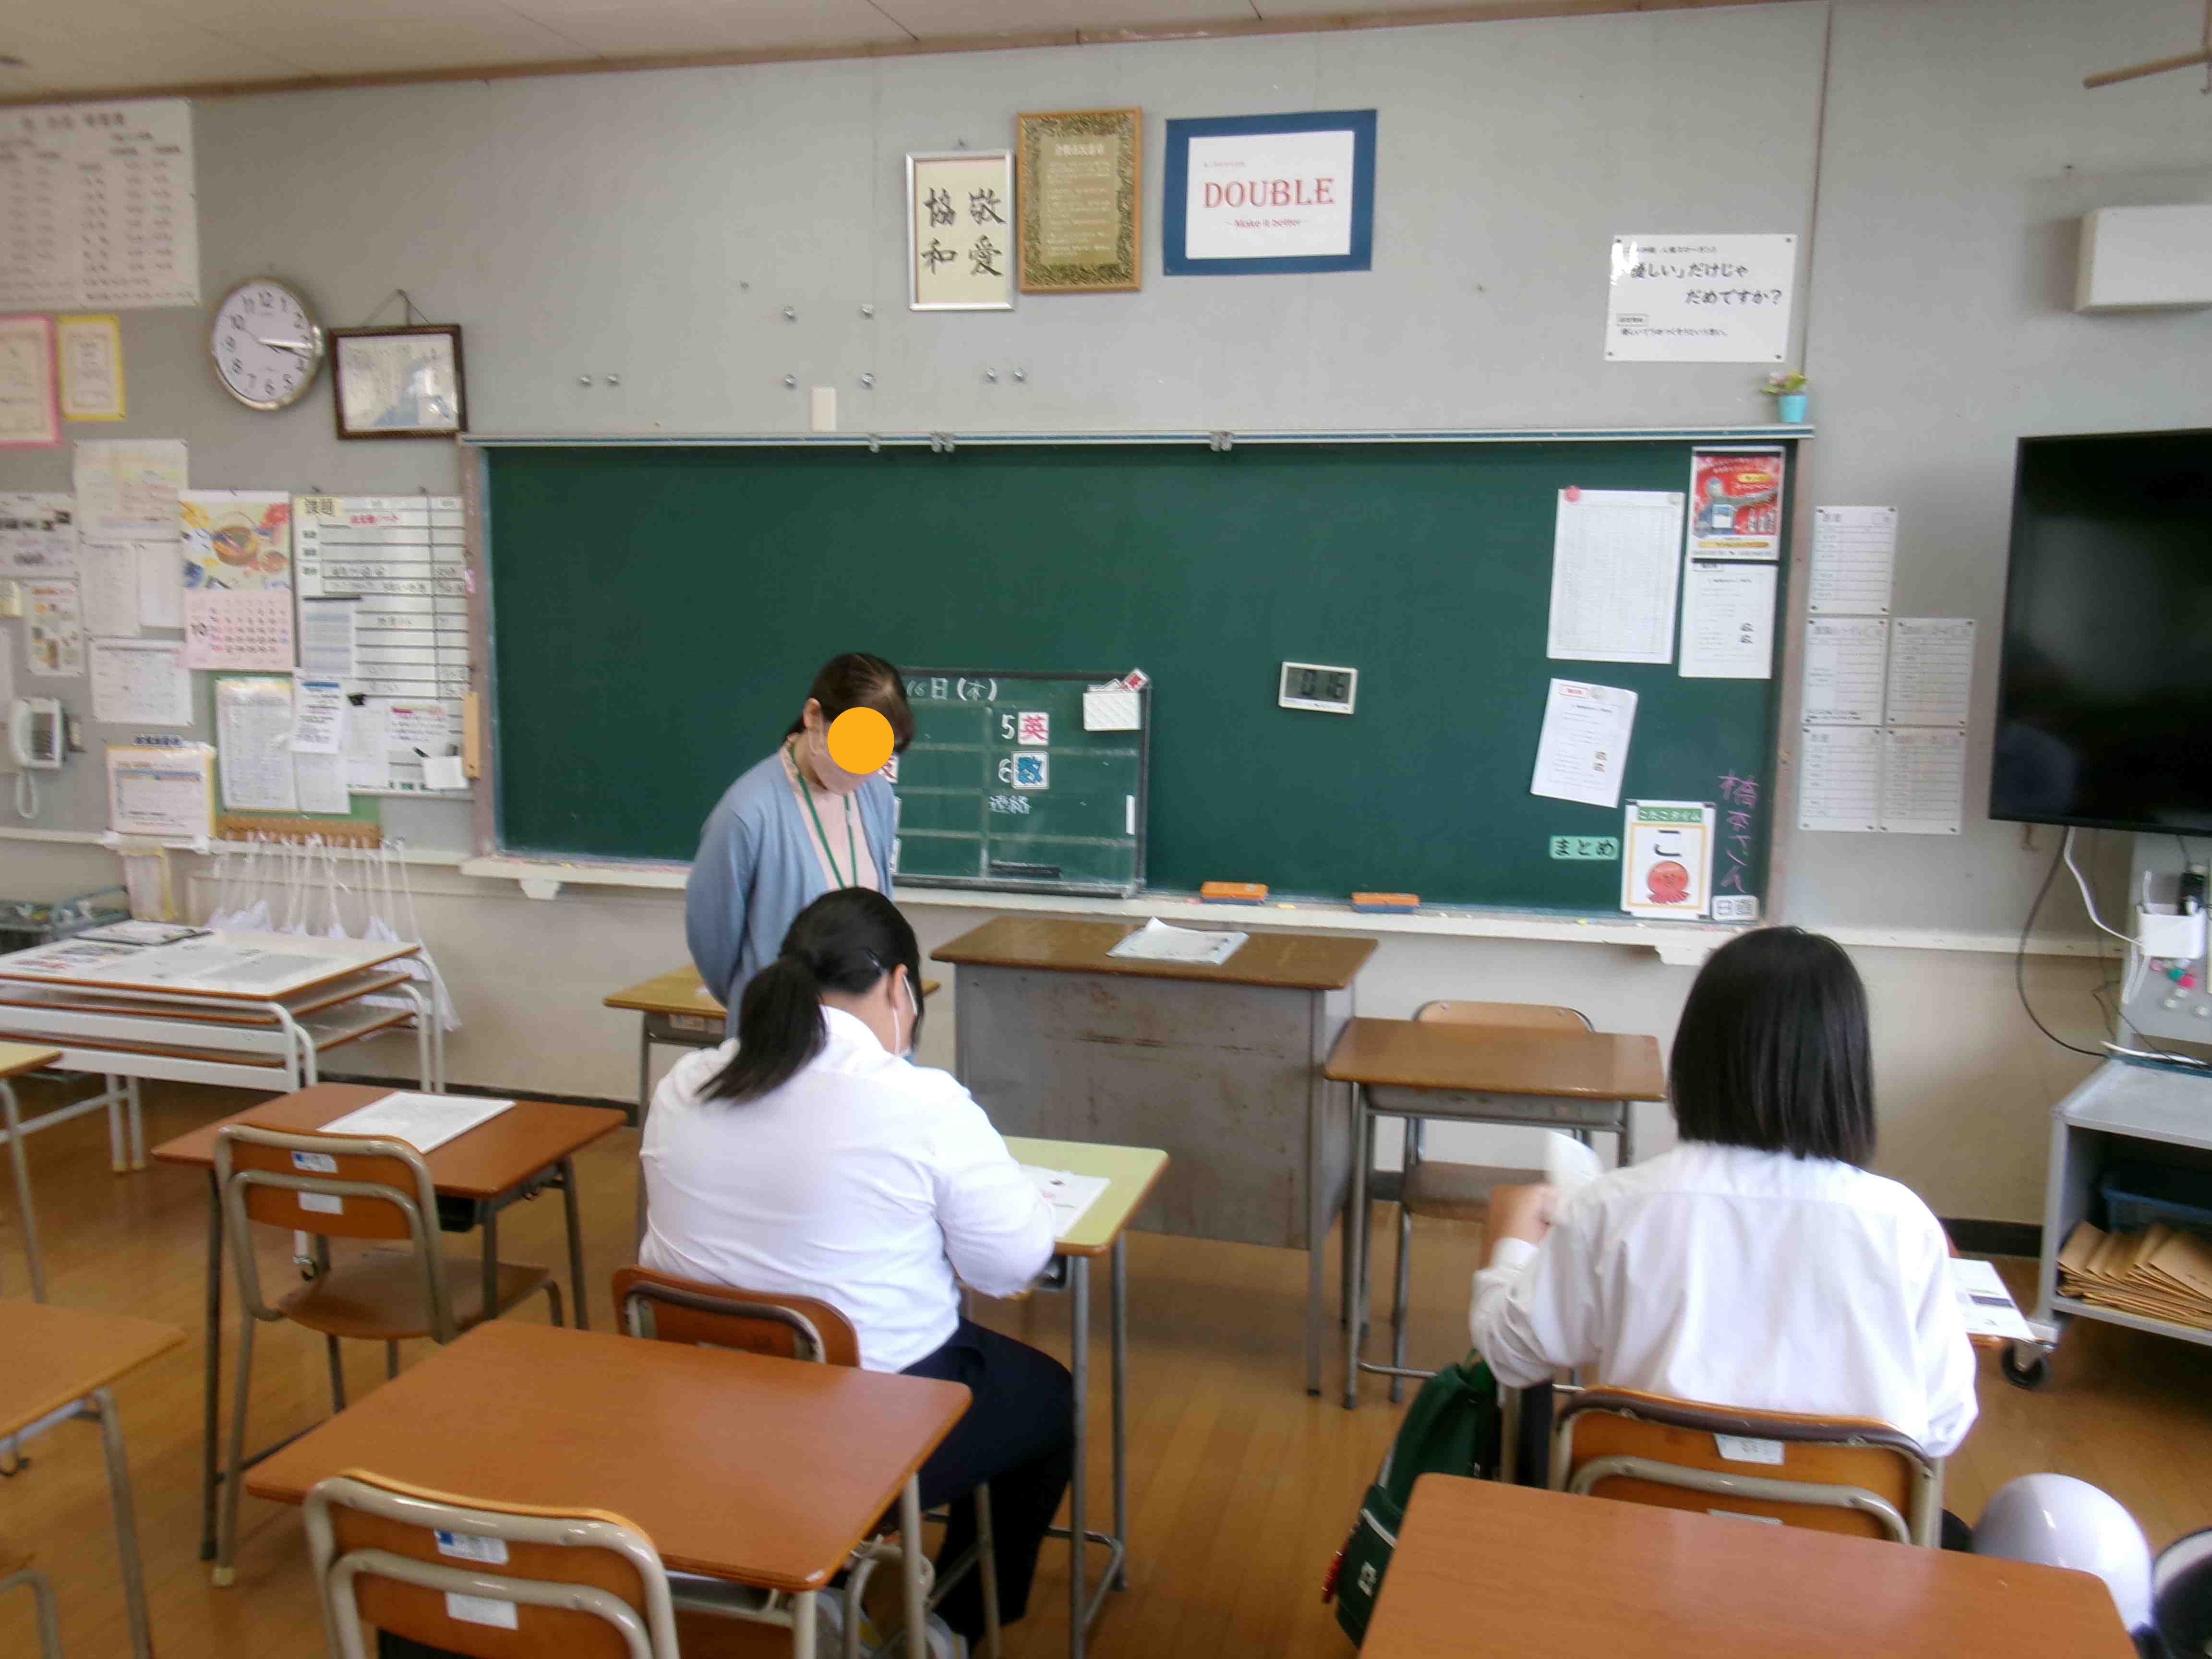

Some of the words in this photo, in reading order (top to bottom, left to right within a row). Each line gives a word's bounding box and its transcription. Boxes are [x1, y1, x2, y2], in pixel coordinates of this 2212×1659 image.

[1203, 178, 1335, 208] DOUBLE
[1001, 714, 1015, 739] 5
[1019, 714, 1048, 741] 英
[998, 758, 1012, 783] 6
[1555, 839, 1615, 857] まとめ
